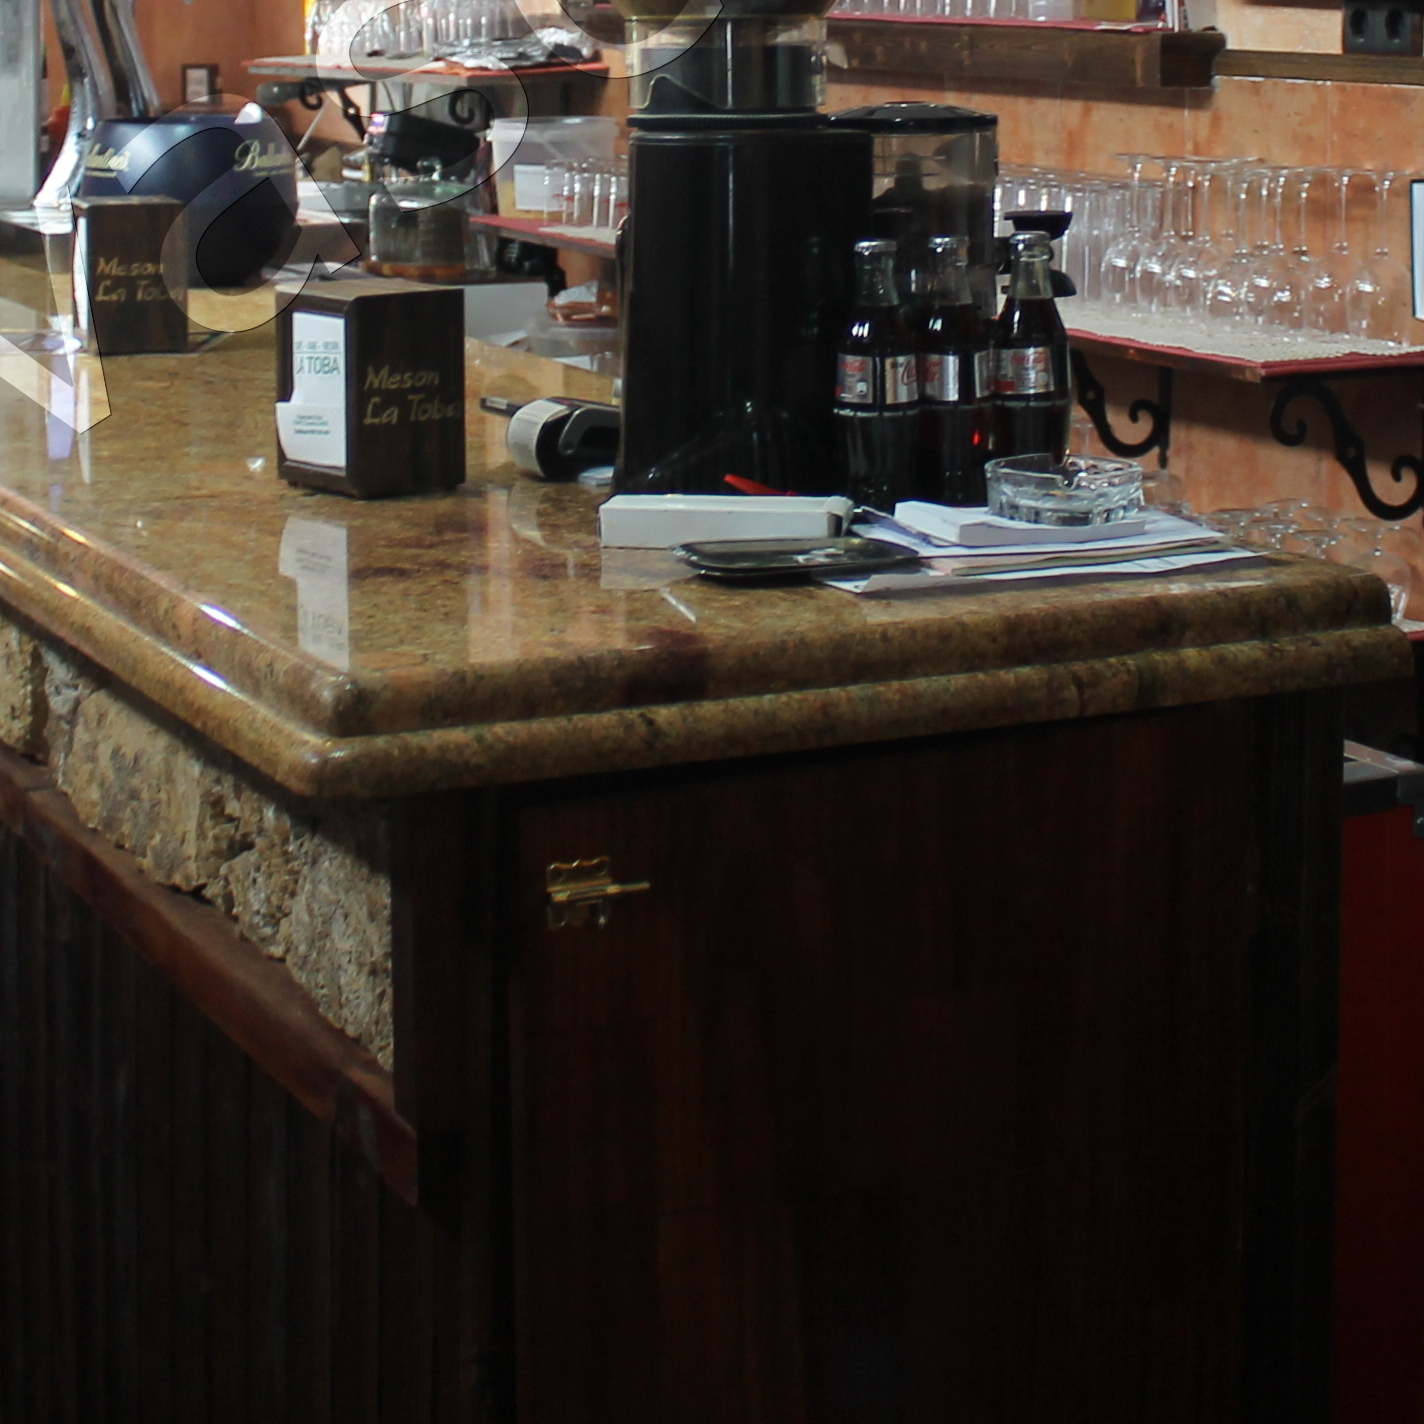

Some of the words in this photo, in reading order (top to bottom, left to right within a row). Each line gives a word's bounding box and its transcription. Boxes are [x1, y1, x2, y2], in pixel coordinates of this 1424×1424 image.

[95, 279, 126, 303] La
[306, 356, 341, 375] TOBA
[363, 364, 440, 391] Meson
[363, 396, 399, 425] La
